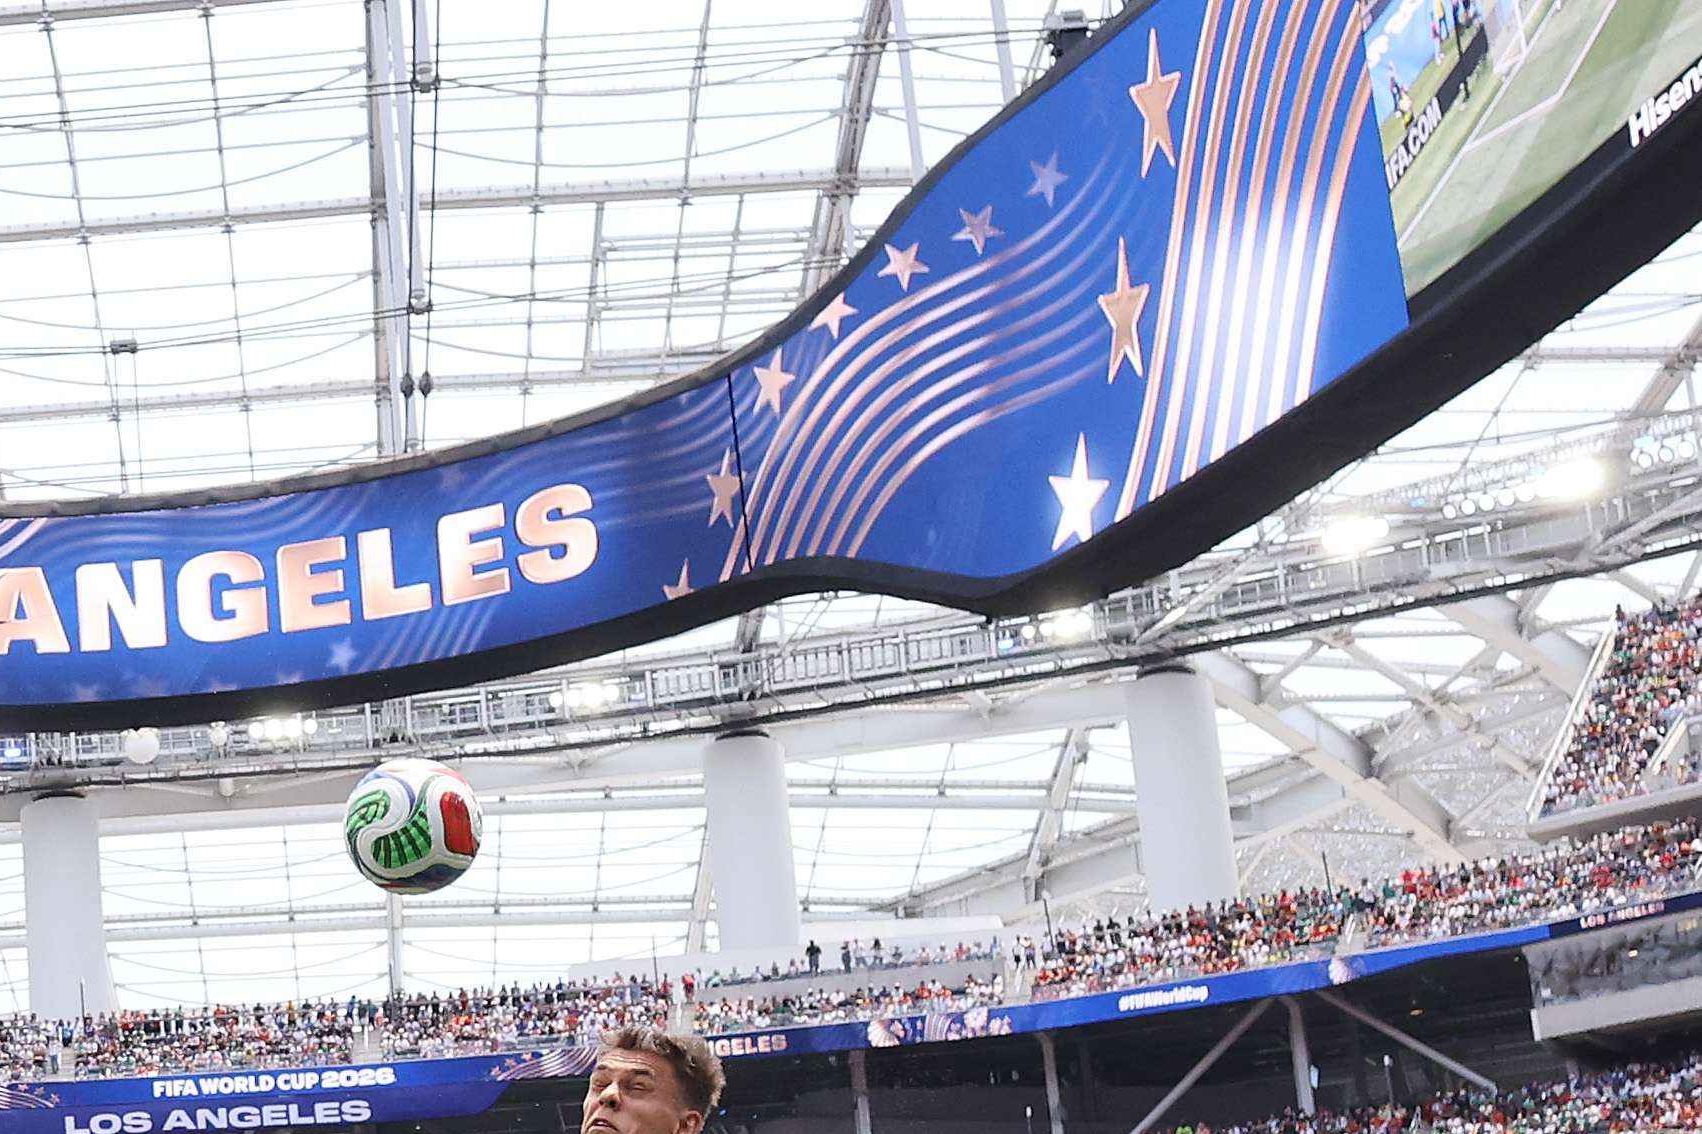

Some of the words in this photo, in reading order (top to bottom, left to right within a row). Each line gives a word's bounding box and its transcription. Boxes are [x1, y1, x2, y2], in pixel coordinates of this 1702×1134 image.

[153, 1079, 200, 1099] FIFA
[200, 1074, 275, 1096] WORLD
[276, 1070, 319, 1092] CUP
[321, 1067, 395, 1088] 2026
[163, 1100, 372, 1131] ANGELES
